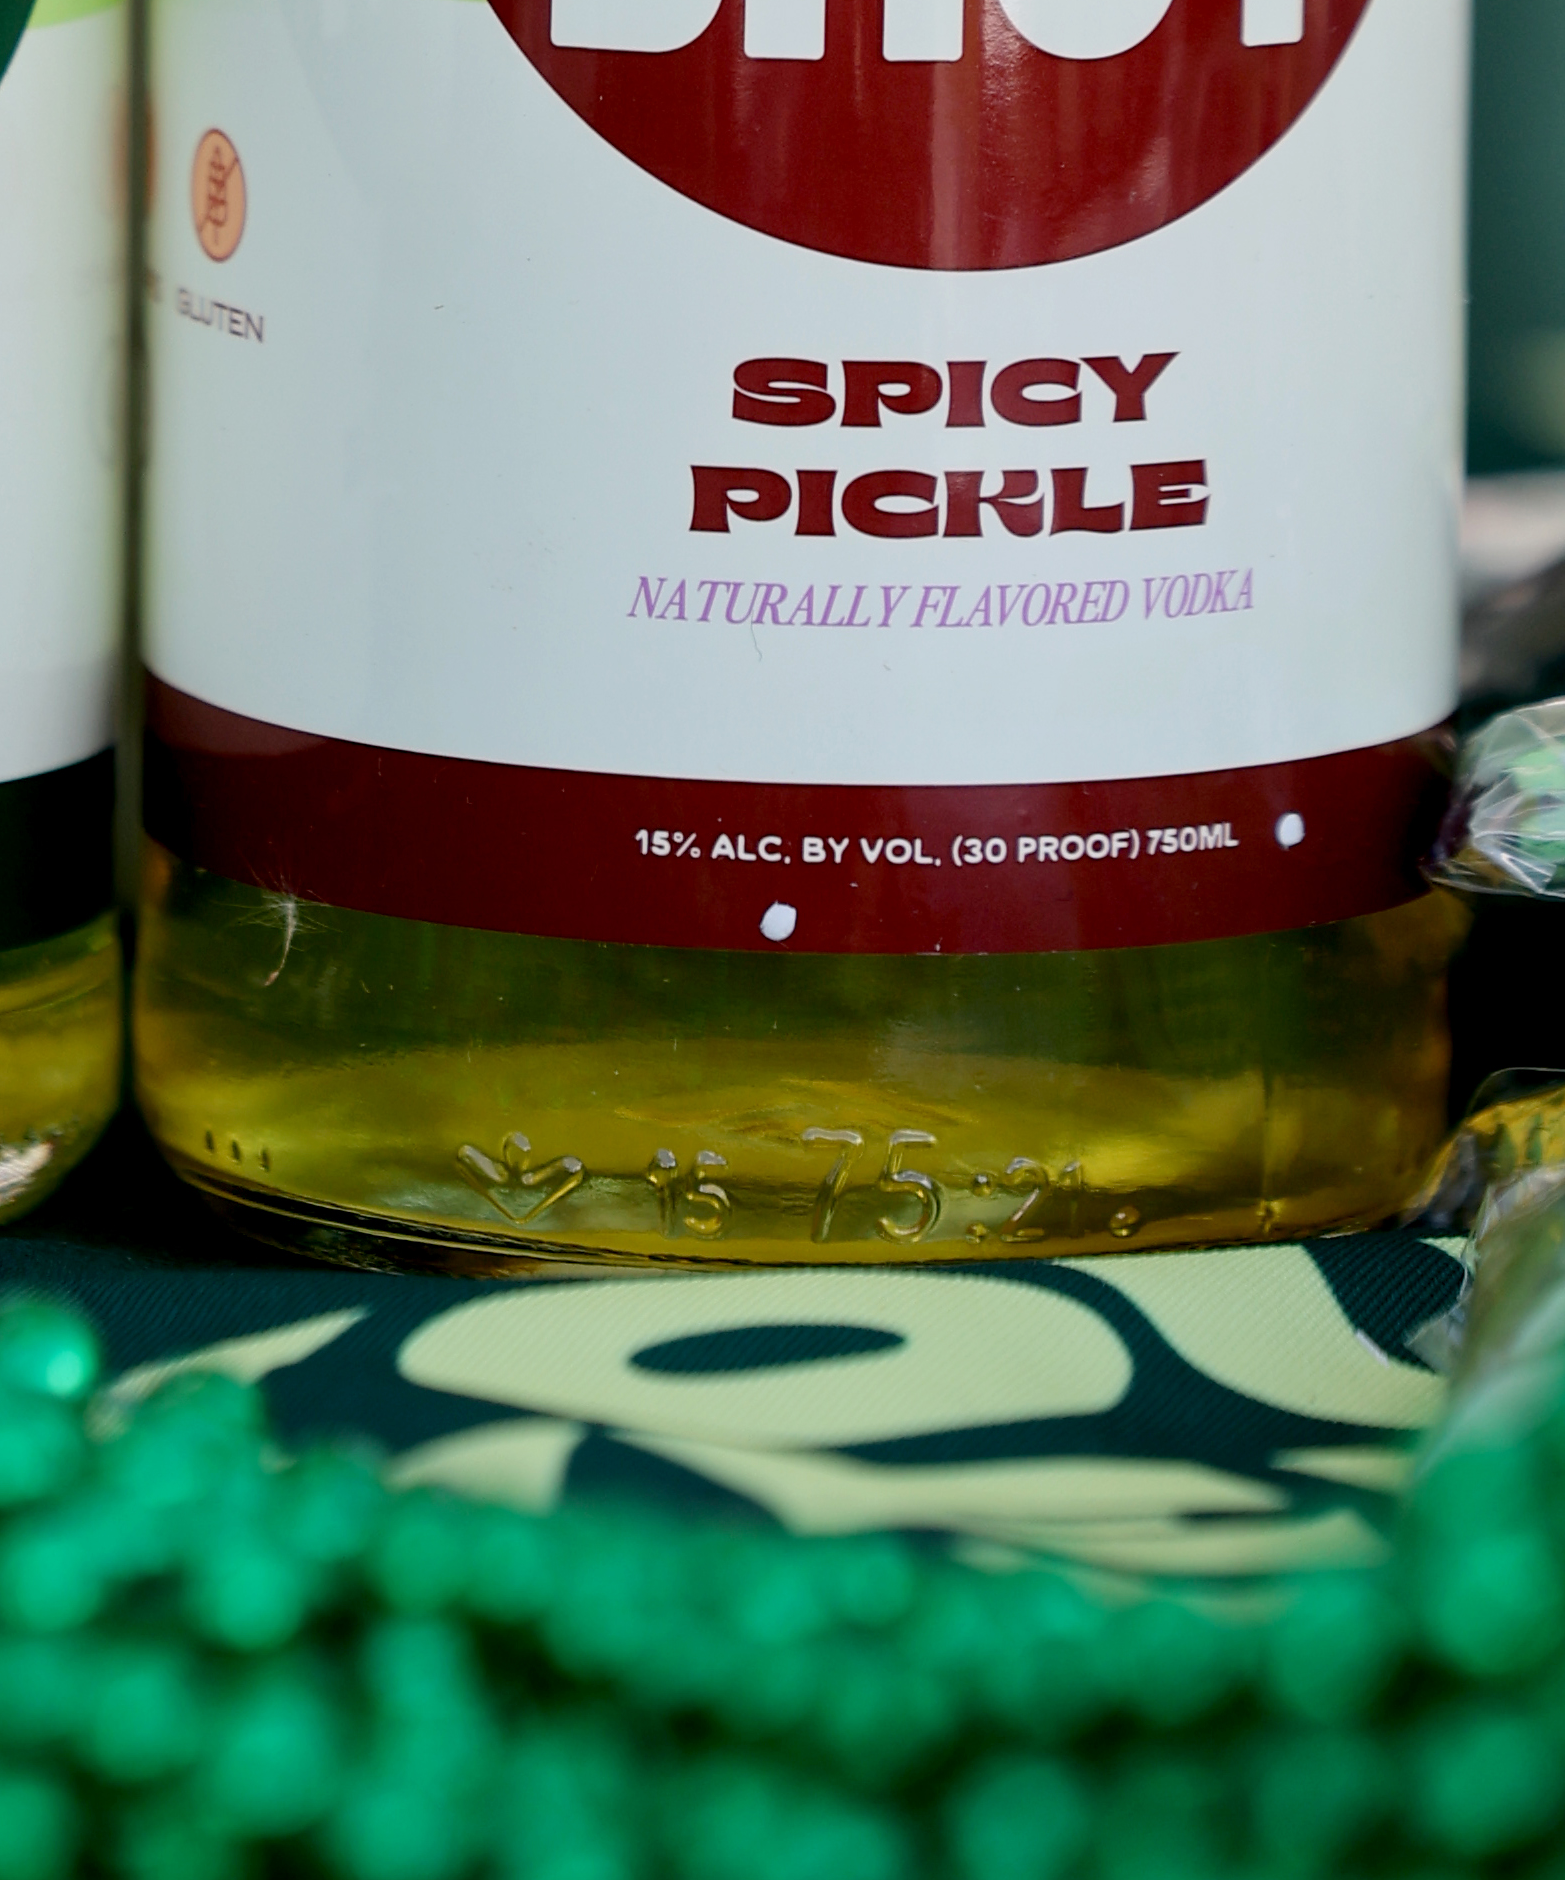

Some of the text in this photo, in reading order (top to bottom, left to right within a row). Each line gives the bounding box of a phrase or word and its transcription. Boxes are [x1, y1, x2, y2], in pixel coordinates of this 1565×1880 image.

[177, 287, 264, 343] GLUTEN
[731, 351, 1180, 428] SPICY
[688, 459, 1210, 540] PICKLE
[626, 567, 1255, 629] NATURALLY FLAVORED VODKA
[635, 829, 701, 859] 15%
[802, 836, 849, 864] BY
[860, 838, 941, 868] VOL.
[951, 835, 1008, 867] (30
[1017, 828, 1140, 863] PROOF)
[1146, 822, 1239, 855] 750ML
